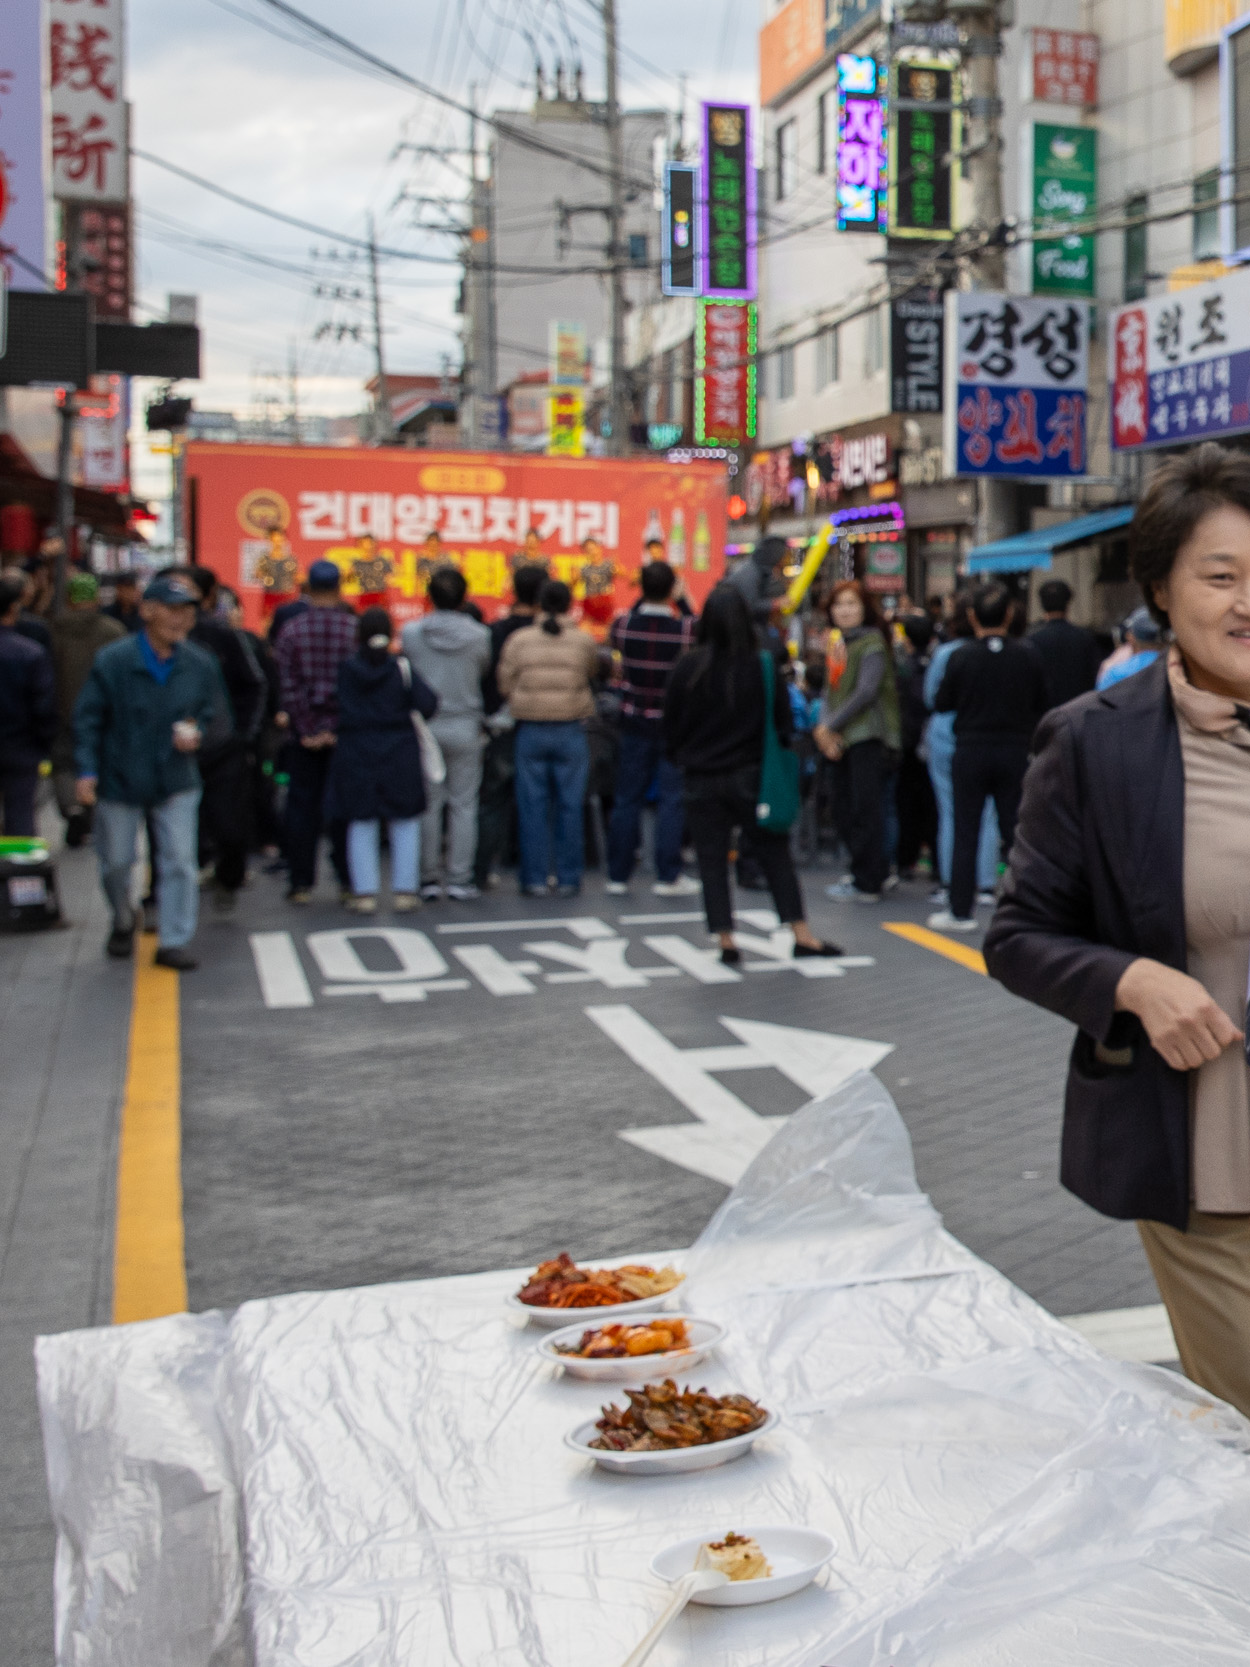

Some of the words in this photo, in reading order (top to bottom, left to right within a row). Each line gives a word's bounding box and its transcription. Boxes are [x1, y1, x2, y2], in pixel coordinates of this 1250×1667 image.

[904, 320, 940, 411] STYLE
[961, 302, 1080, 382] 경성
[1156, 295, 1226, 363] 원조
[297, 490, 620, 550] 건대양꼬치거리
